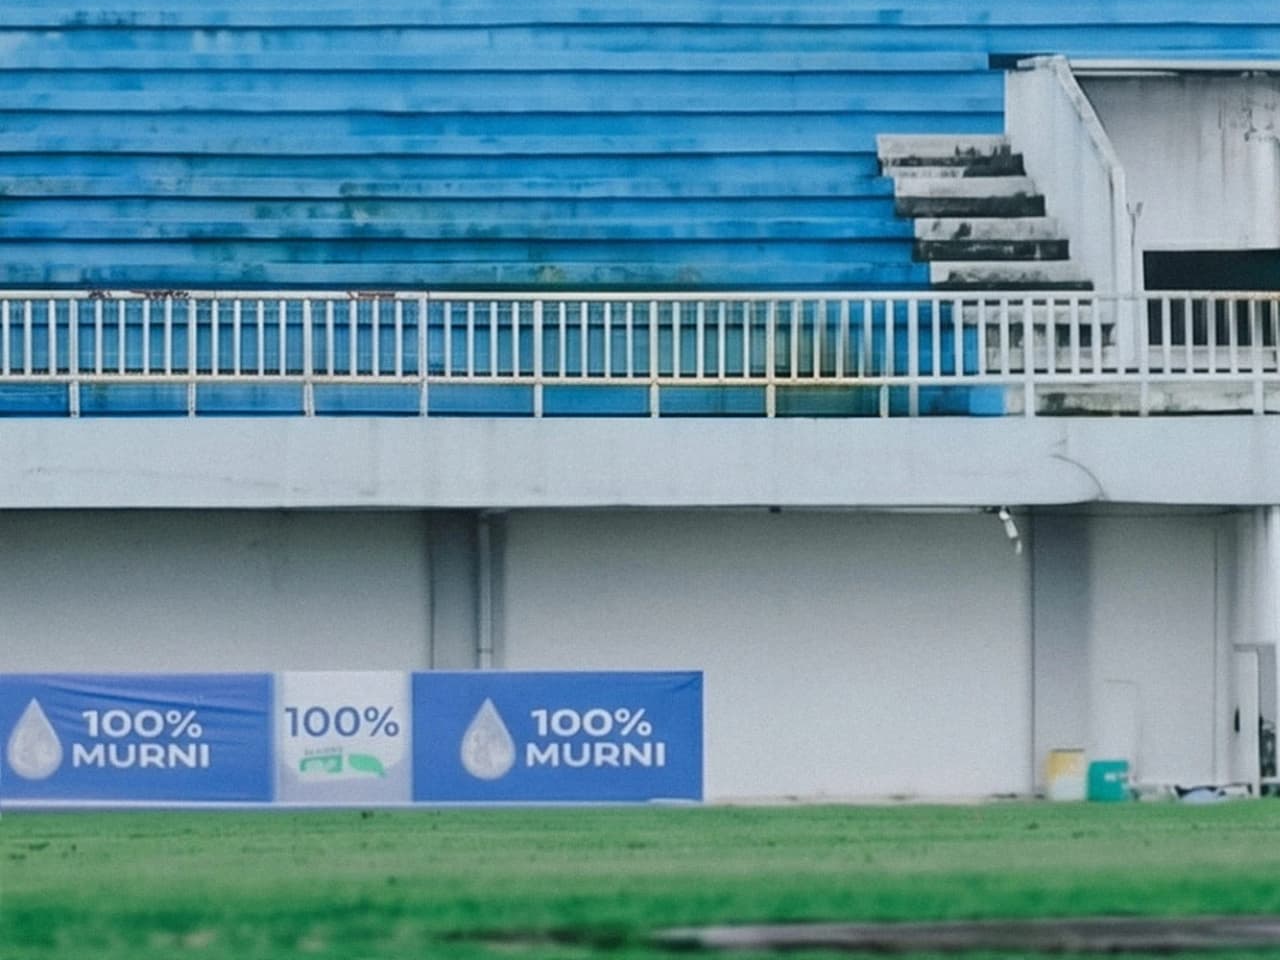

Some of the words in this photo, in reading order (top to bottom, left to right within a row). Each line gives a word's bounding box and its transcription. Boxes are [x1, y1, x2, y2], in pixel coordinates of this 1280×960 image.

[82, 709, 202, 738] 100%
[284, 706, 400, 737] 100%
[530, 708, 653, 737] 100%
[72, 743, 210, 768] MURNI
[526, 742, 666, 767] MURNI
